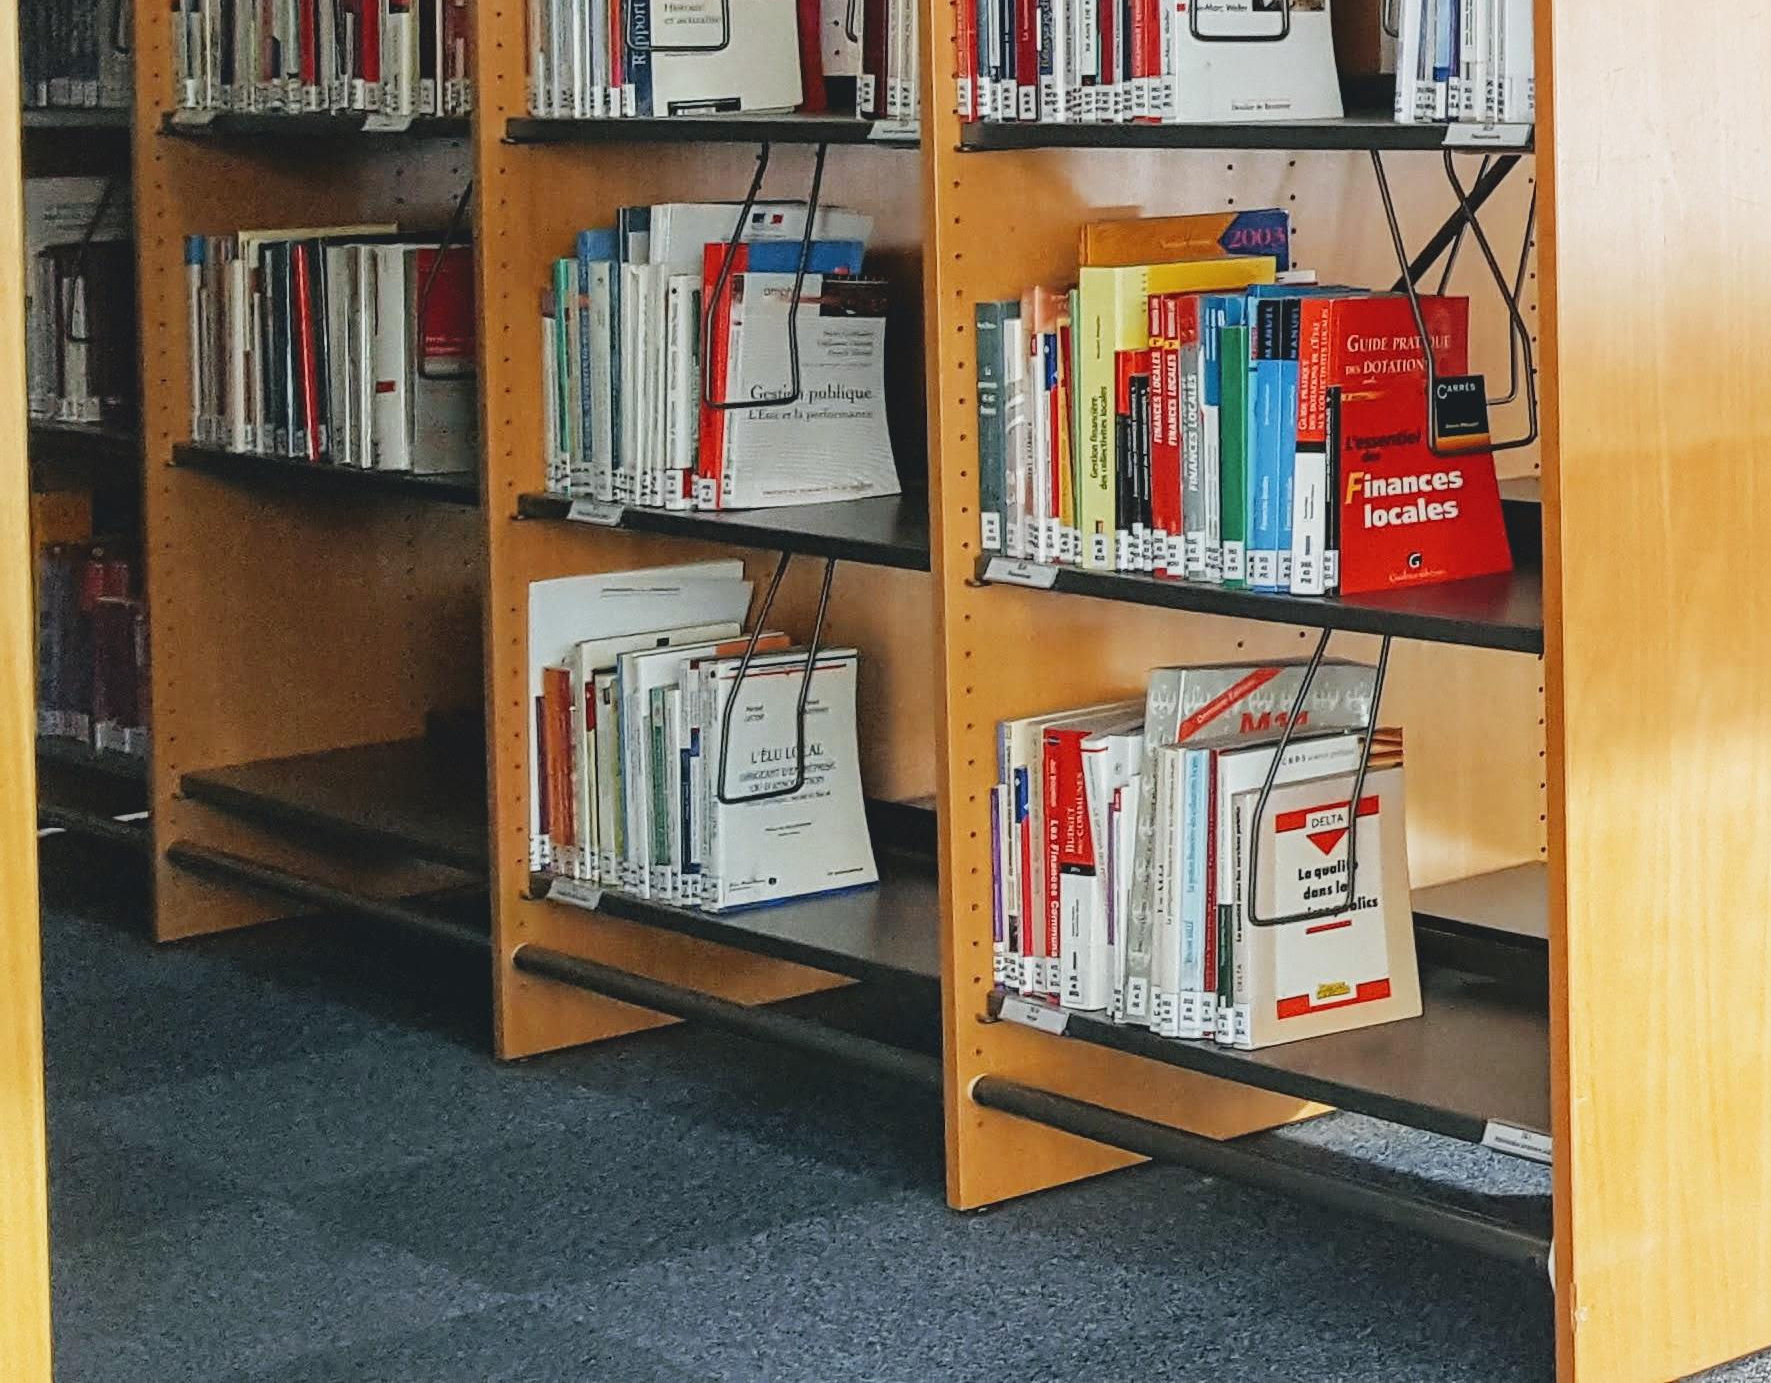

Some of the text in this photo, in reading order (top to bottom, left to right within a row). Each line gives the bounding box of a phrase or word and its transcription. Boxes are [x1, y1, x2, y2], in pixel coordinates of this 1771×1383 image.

[631, 2, 649, 65] Rpport
[1264, 306, 1273, 358] MANUEL
[1363, 358, 1426, 374] DOTATION
[750, 384, 873, 405] Gestin publique
[1151, 351, 1163, 444] FINANCES LOCALES
[1166, 354, 1178, 446] FINANCES LOCALES
[1299, 402, 1308, 430] GUIDE
[1089, 397, 1100, 479] Gestion financière
[1099, 386, 1108, 490] des collectivités locales
[1185, 374, 1198, 491] FINANCES LOCALES
[1344, 469, 1464, 505] Finances
[1363, 497, 1459, 529] locales
[751, 743, 824, 764] L'ÉLU LOAL
[1311, 813, 1344, 829] DELTA
[1050, 844, 1059, 896] Finances
[1298, 860, 1358, 881] La quali
[1303, 885, 1332, 900] dans
[1050, 900, 1059, 957] Communa
